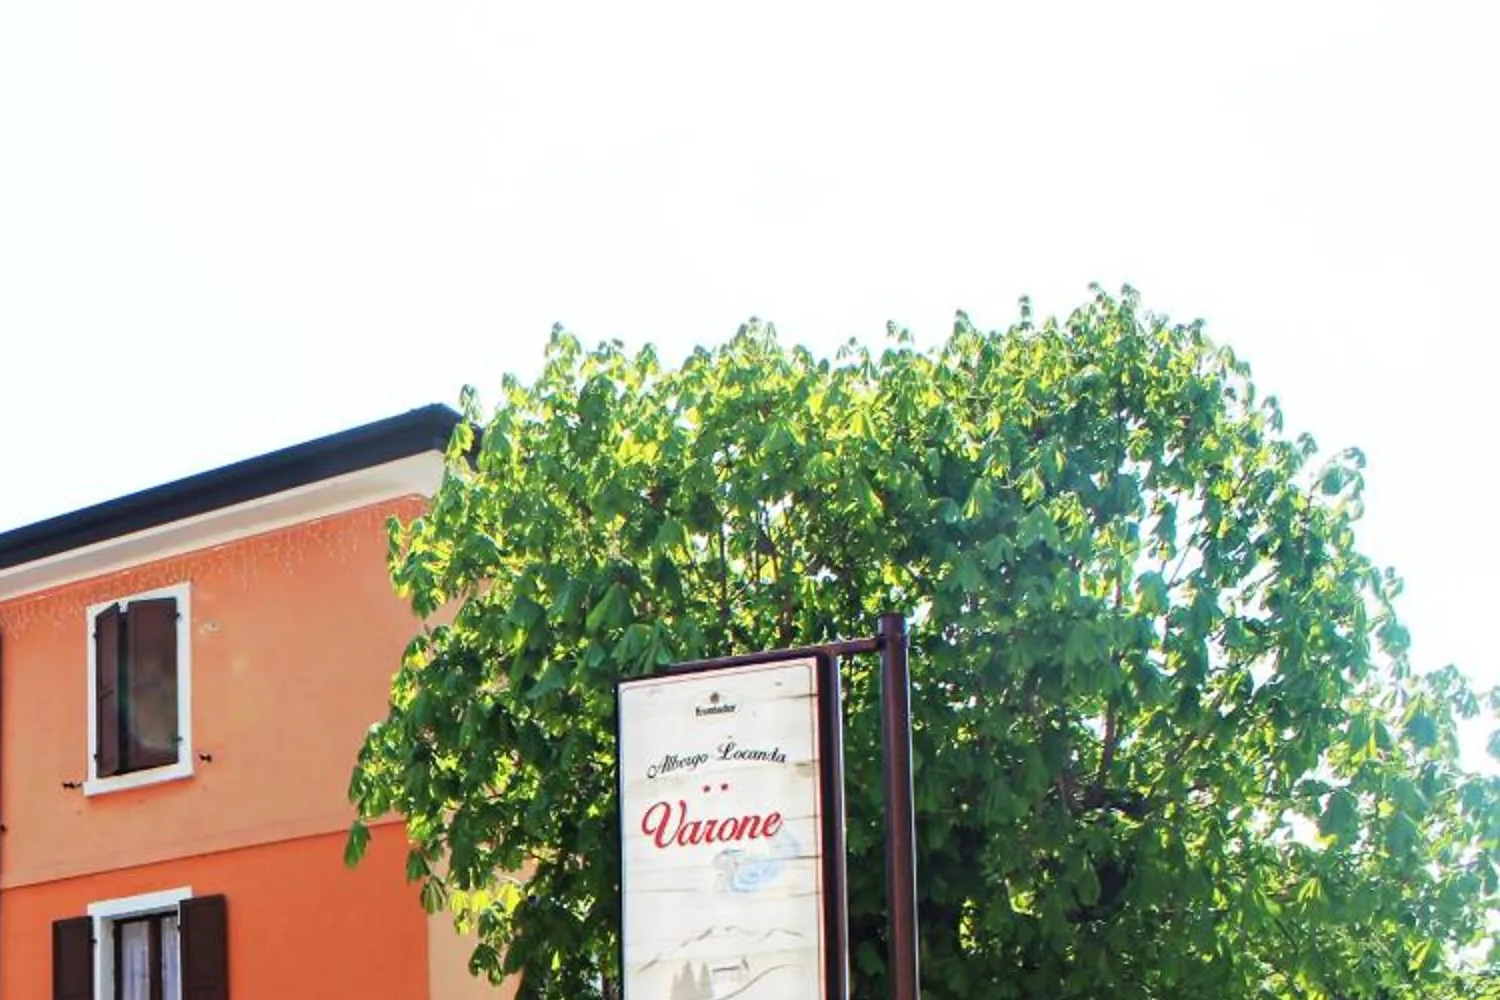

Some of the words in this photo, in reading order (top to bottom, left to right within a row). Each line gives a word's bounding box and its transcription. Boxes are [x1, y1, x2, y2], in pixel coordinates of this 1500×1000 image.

[646, 753, 709, 779] Albergo
[717, 741, 788, 765] Locanda
[641, 799, 783, 849] Varone
